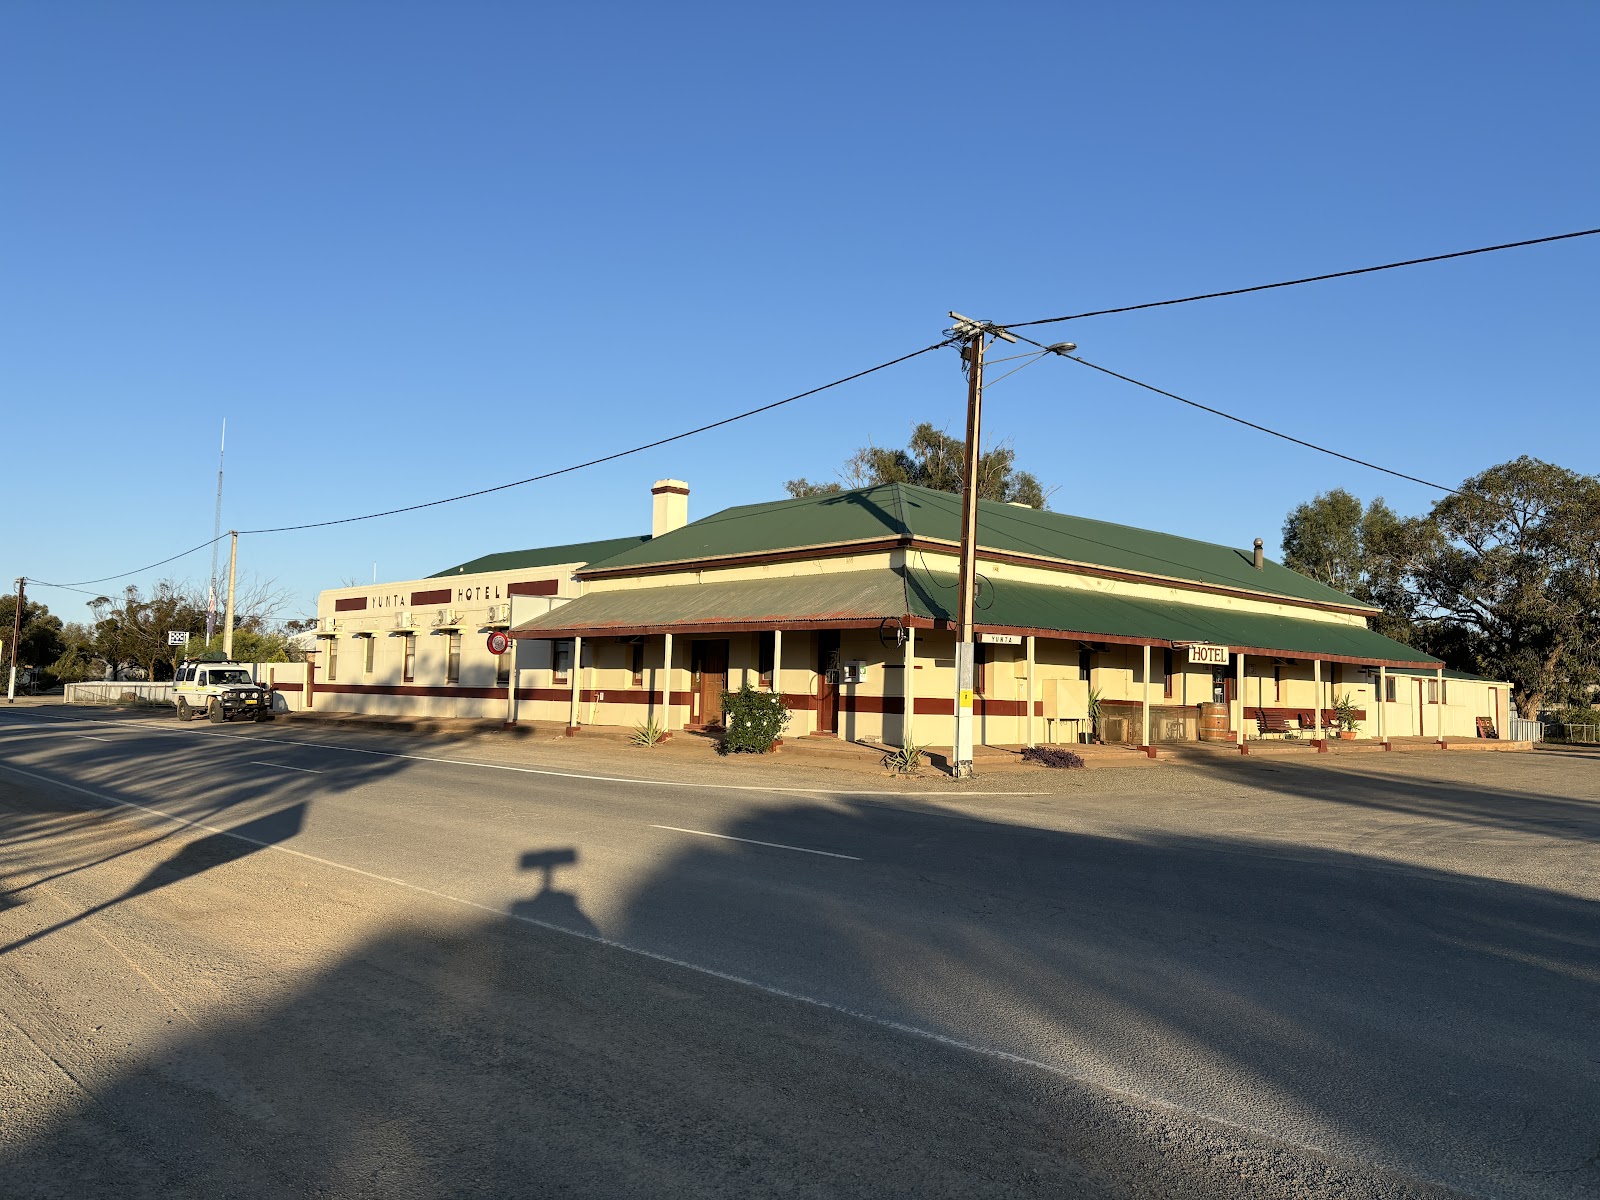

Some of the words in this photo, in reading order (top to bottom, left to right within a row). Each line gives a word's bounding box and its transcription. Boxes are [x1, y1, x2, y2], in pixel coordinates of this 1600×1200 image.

[372, 594, 405, 609] YUNTA
[458, 585, 500, 602] HOTEL
[992, 635, 1012, 643] YUNTA
[1192, 646, 1227, 662] HOTEL
